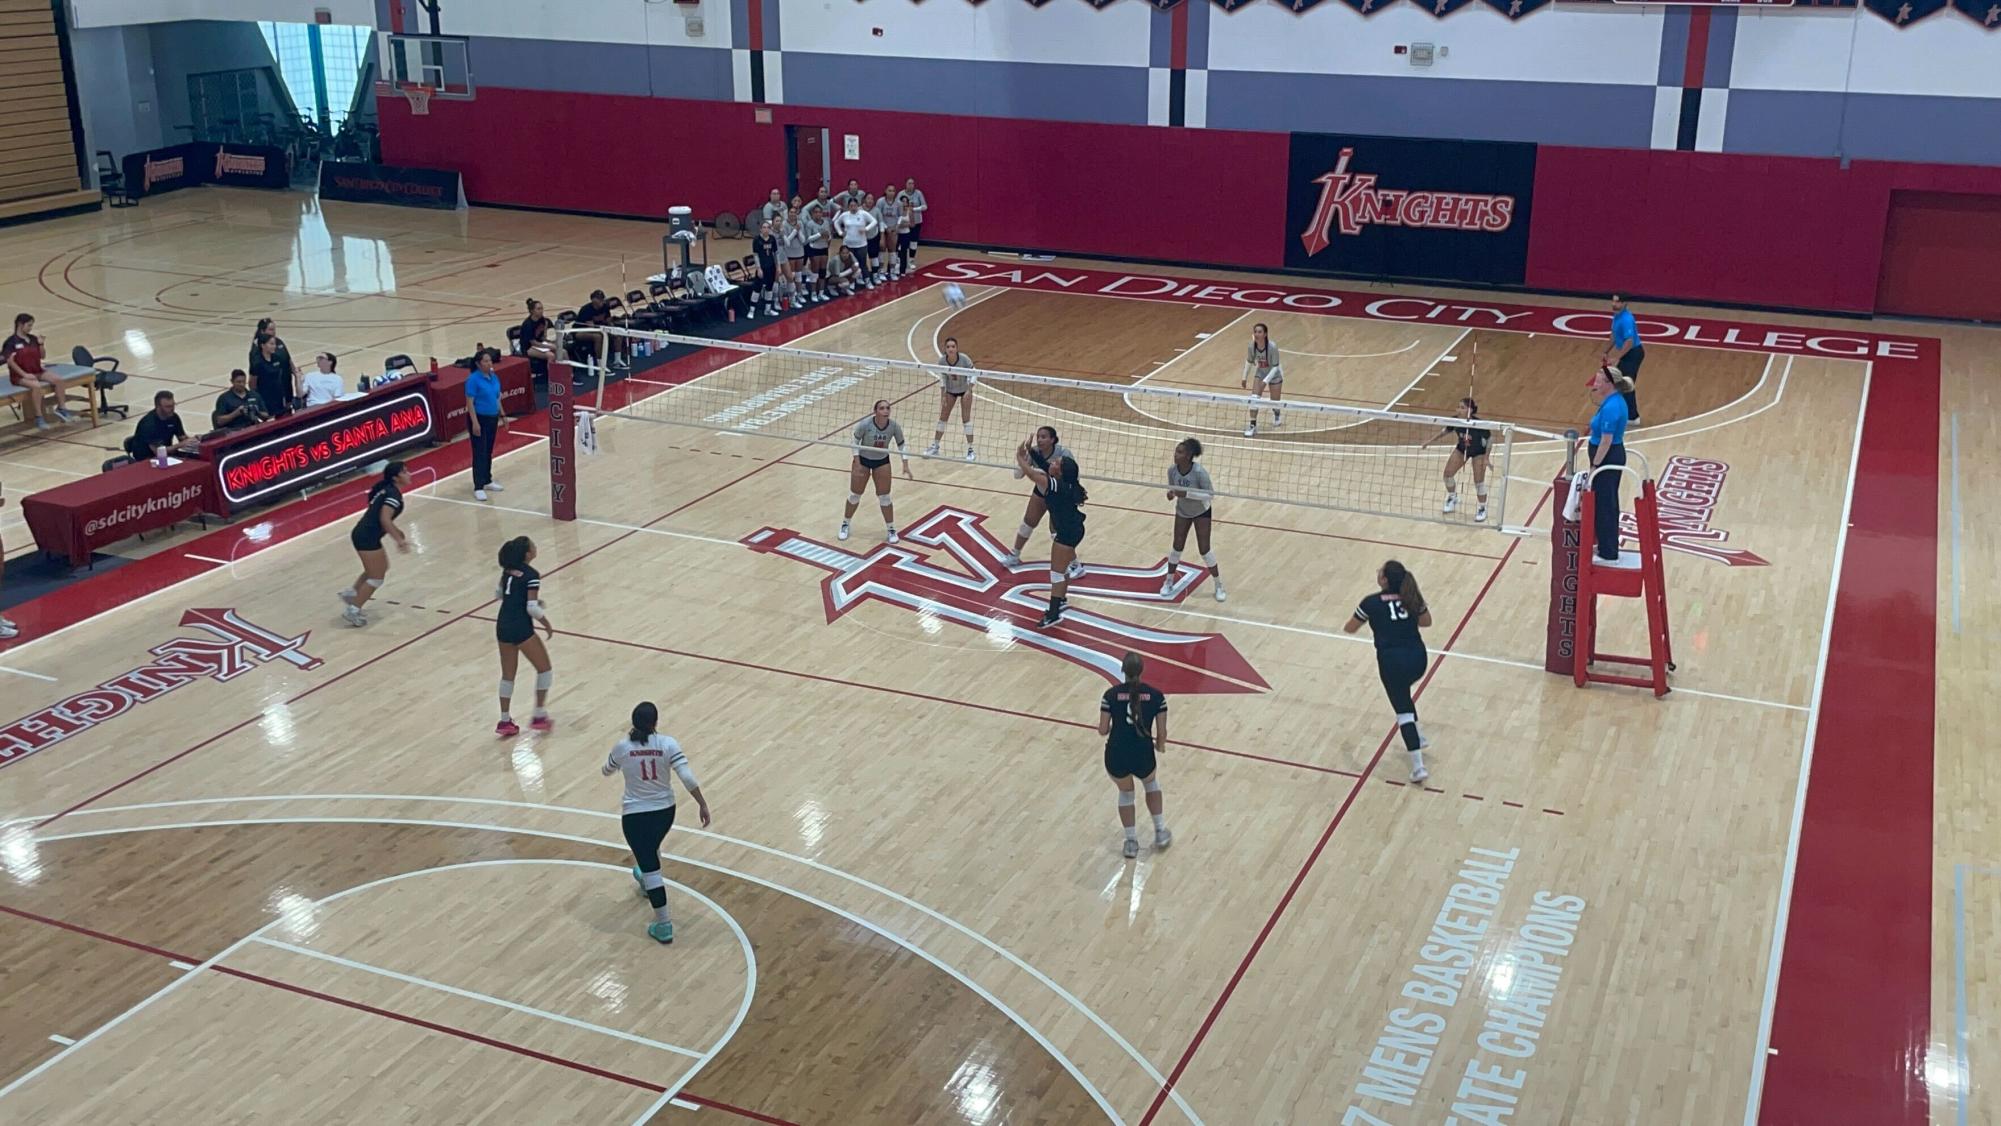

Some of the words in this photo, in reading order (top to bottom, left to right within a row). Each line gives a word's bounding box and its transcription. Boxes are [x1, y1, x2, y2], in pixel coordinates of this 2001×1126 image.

[1301, 147, 1515, 257] KNIGHTS
[923, 262, 1089, 287] SAN
[1098, 276, 1343, 308] DIEGO
[1364, 298, 1533, 324] CITY
[1551, 313, 1919, 359] COLLEGE
[226, 445, 309, 491] KNIGHTS
[332, 417, 389, 453] SANTA
[390, 404, 426, 433] ANA
[84, 483, 203, 536] @sdcityknights
[1558, 519, 1581, 658] NIGHTS
[640, 758, 658, 780] 11
[1355, 1008, 1447, 1106] MENS
[1401, 847, 1521, 1007] BASKETBALL
[1477, 891, 1586, 1059] CHAMPIONS
[1444, 1059, 1527, 1126] ATE
